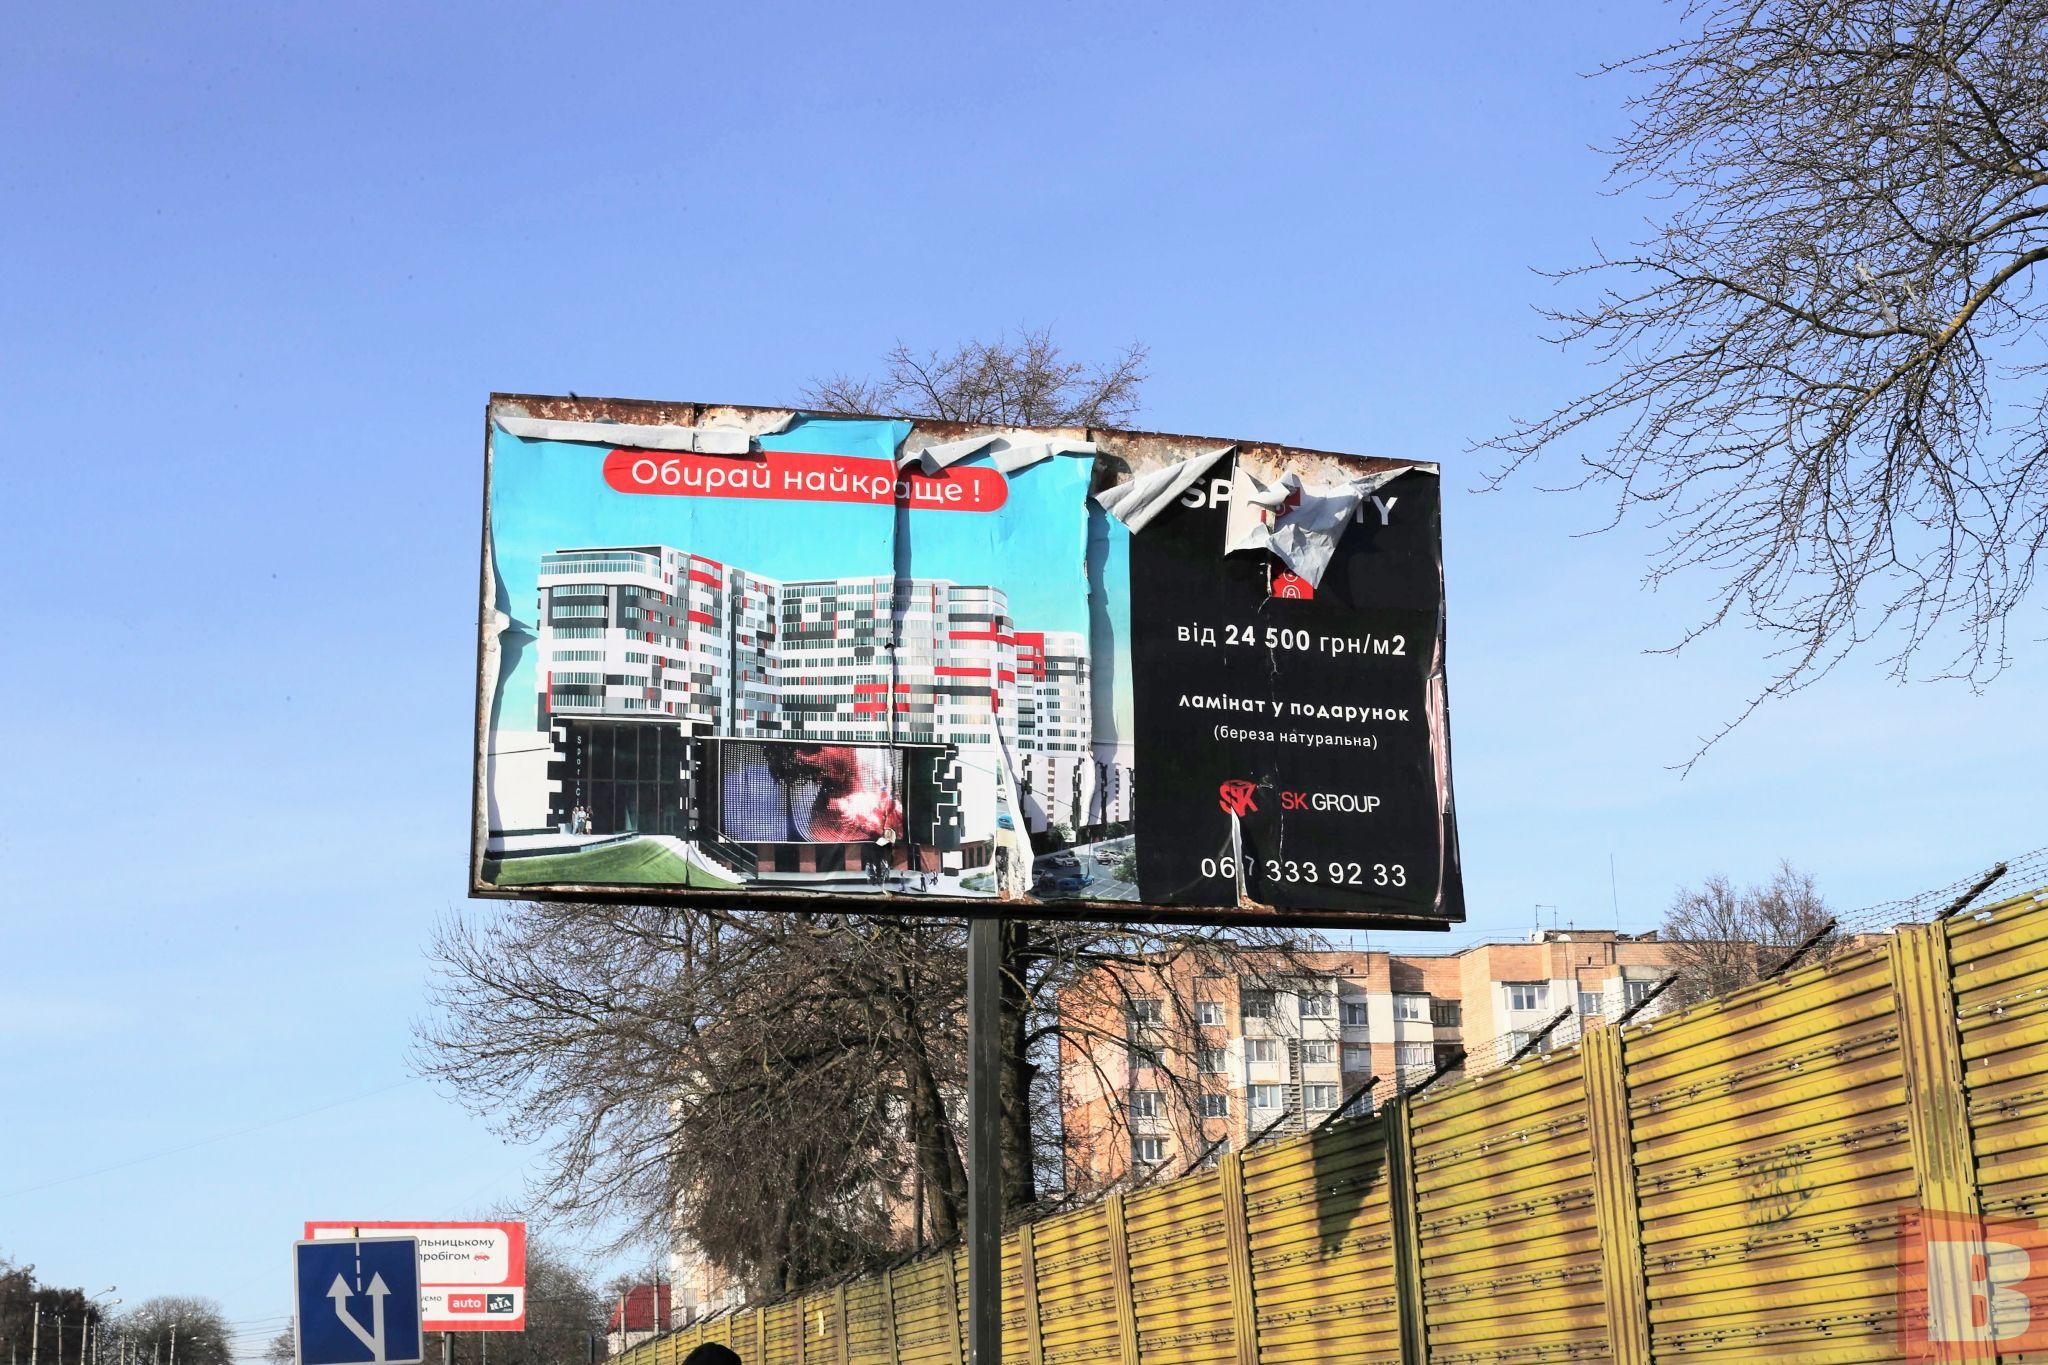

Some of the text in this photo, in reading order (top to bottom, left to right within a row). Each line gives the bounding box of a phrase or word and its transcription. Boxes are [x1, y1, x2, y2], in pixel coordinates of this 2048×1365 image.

[631, 458, 981, 503] Обирай найкраще !
[1177, 622, 1407, 658] від 24 500 грн/м2
[1179, 693, 1410, 723] ламінат у подарунок
[1213, 724, 1378, 750] (береза натуральна)
[1281, 790, 1381, 813] SK GROUP
[1265, 859, 1319, 883] 333
[1328, 862, 1363, 885] 92
[1373, 863, 1407, 887] 33
[419, 1239, 494, 1248] льницькому
[453, 1298, 481, 1308] auto
